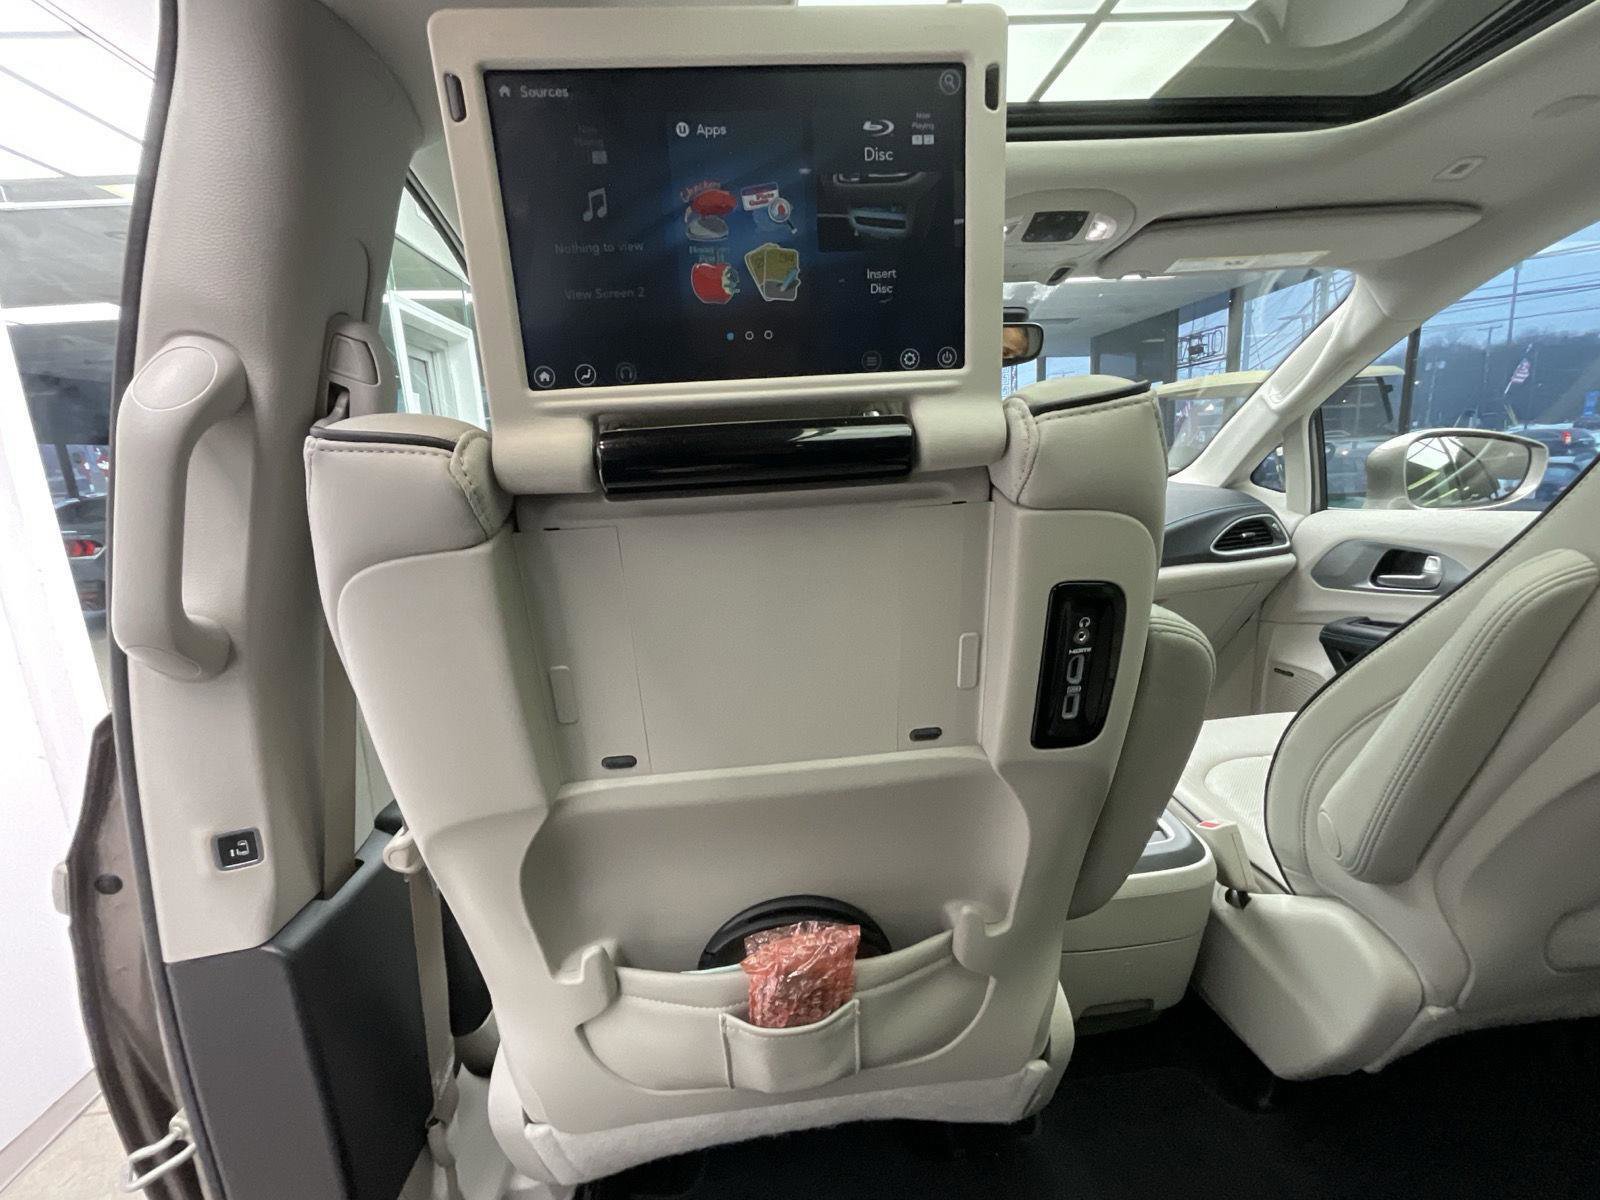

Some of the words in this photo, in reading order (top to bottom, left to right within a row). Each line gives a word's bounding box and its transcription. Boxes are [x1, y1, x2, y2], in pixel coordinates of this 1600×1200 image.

[520, 85, 569, 98] Sources
[696, 124, 727, 139] Apps
[864, 146, 894, 161] Disc
[554, 241, 600, 256] Nothing
[603, 243, 615, 253] to
[619, 242, 644, 252] view
[867, 268, 897, 279] Insert
[564, 289, 593, 300] View
[595, 288, 634, 299] Screen
[636, 286, 645, 298] 2
[870, 283, 894, 294] Disc
